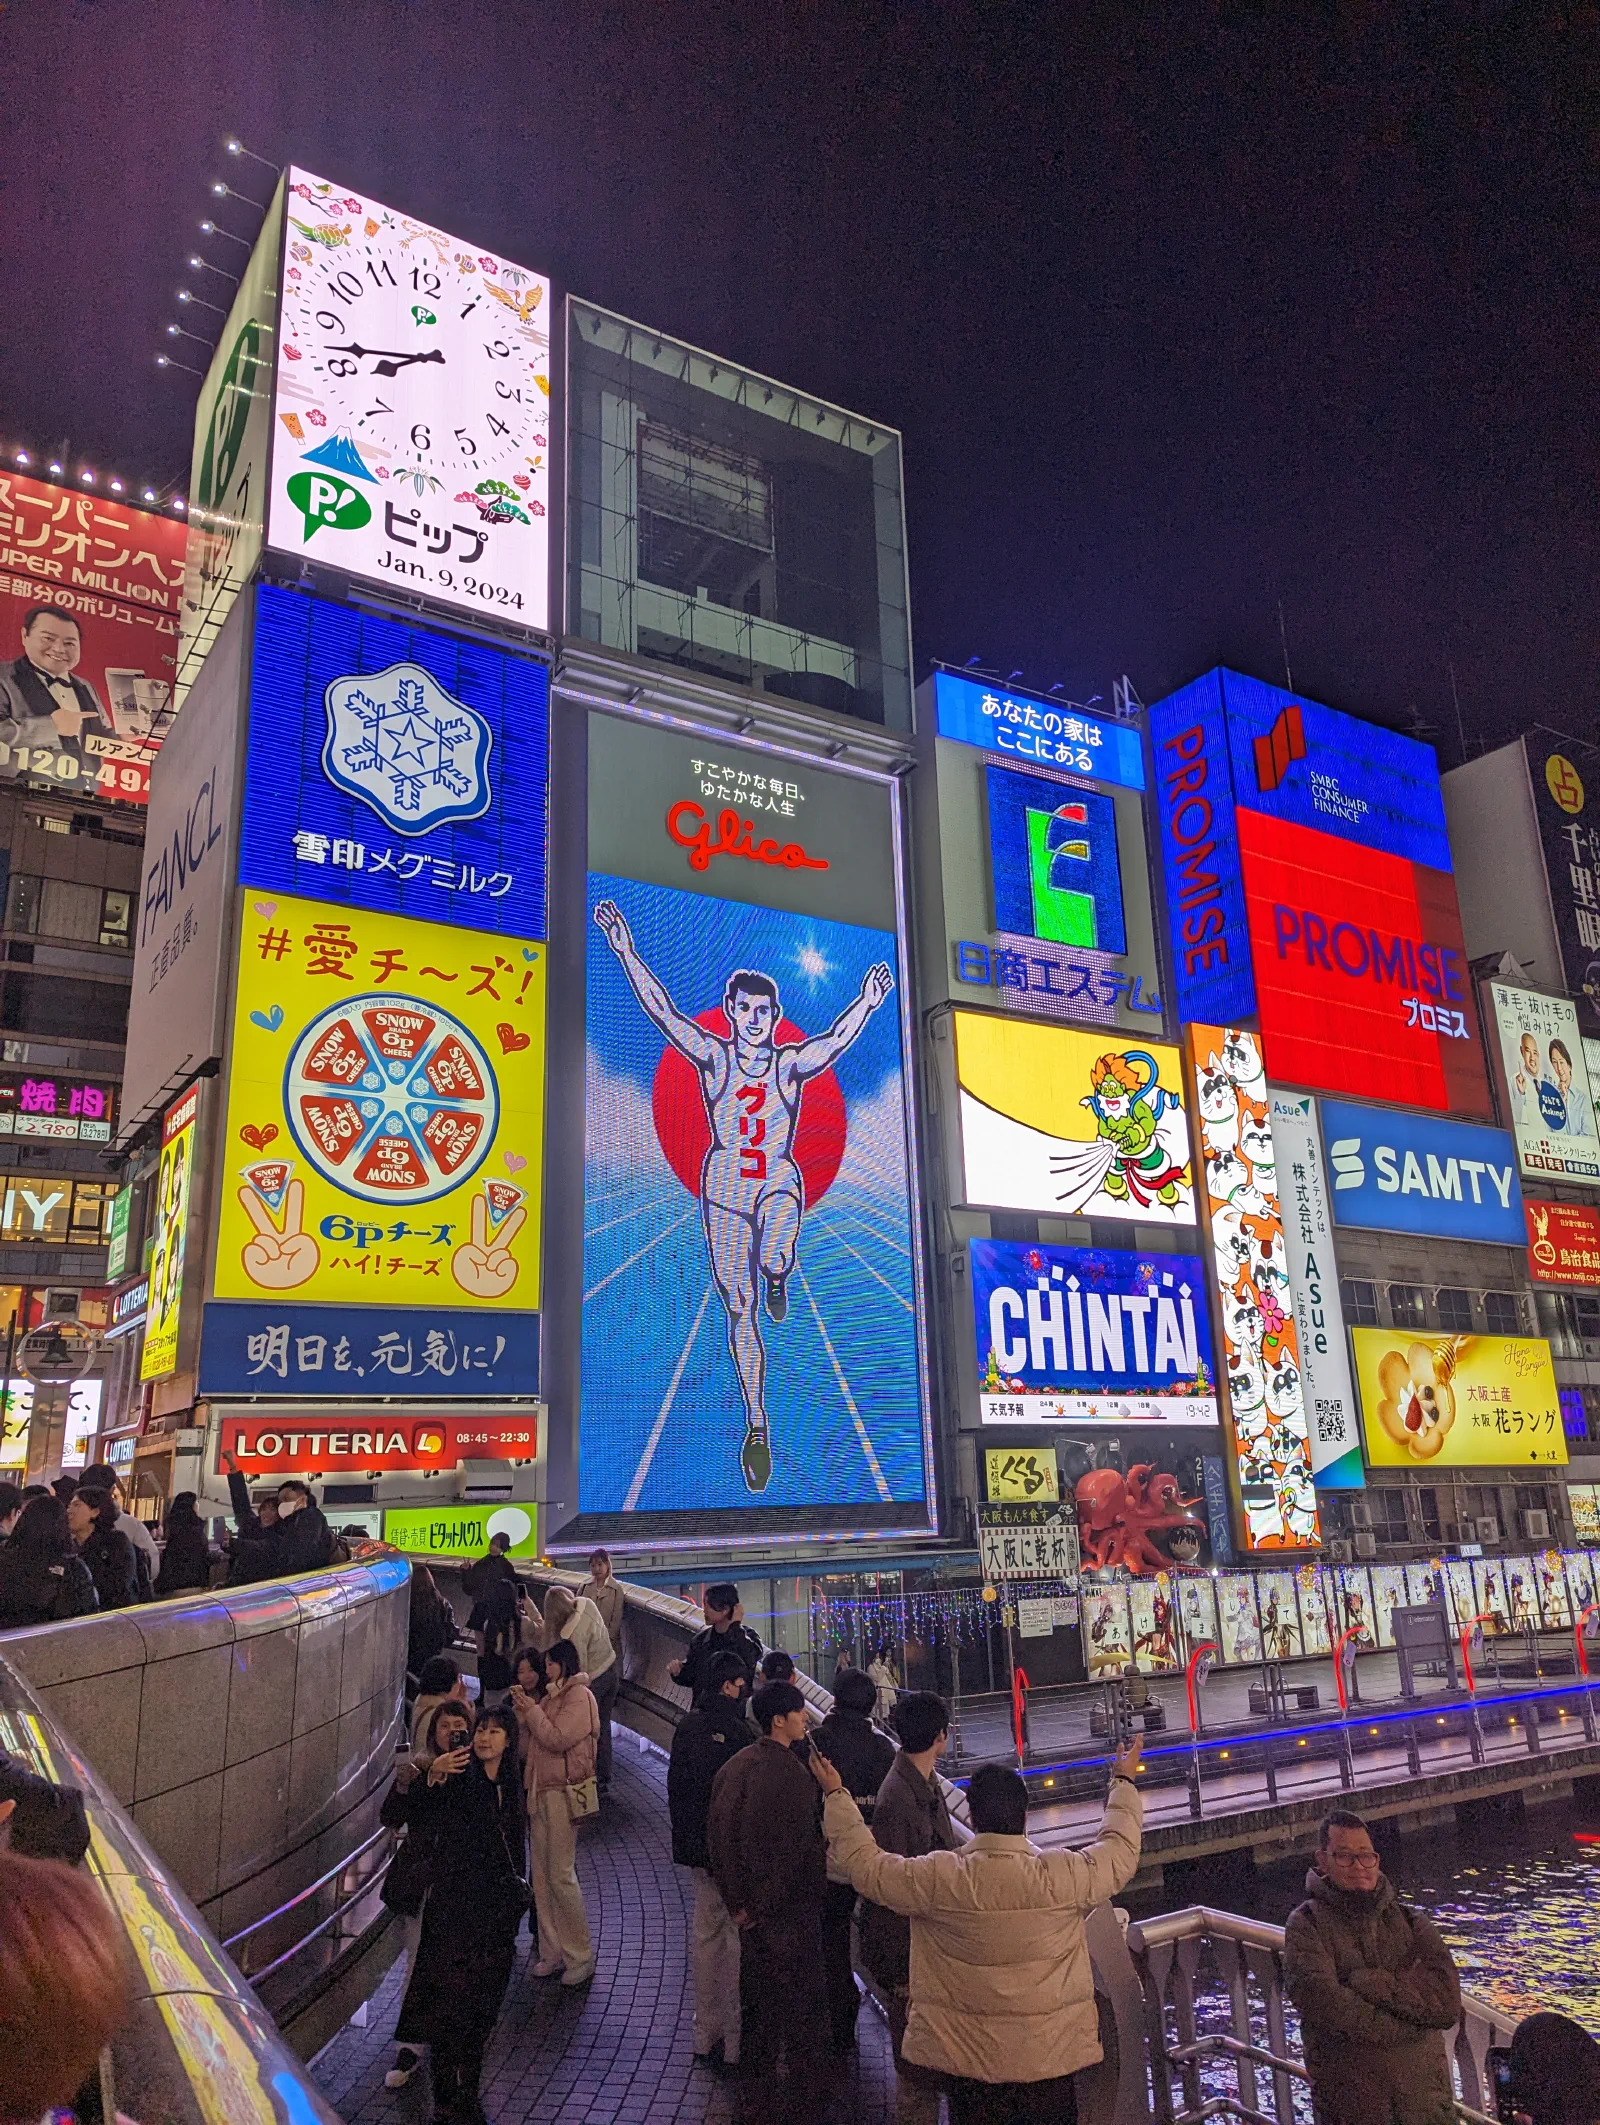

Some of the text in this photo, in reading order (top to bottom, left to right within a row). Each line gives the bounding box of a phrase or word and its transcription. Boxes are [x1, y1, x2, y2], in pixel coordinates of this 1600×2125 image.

[326, 270, 365, 307] 10
[366, 261, 399, 288] 11
[407, 266, 443, 301] 12
[315, 310, 346, 336] 9
[460, 301, 478, 321] 1
[483, 339, 514, 361] 2
[326, 358, 358, 379] 8
[495, 381, 522, 404] 3
[365, 397, 395, 418] 7
[410, 424, 431, 450] 6
[485, 413, 508, 437] 4
[454, 427, 478, 456] 5
[385, 500, 489, 564] ピップ
[377, 551, 431, 585] Jan.
[464, 577, 525, 612] 2024
[981, 693, 1103, 746] あなたの家は
[997, 726, 1093, 772] ここにある
[0, 742, 150, 793] 120-49
[691, 759, 805, 801] すこやかな毎日、
[1310, 771, 1340, 791] SMBC
[700, 780, 796, 817] ゆたかな人生
[1311, 784, 1370, 814] CONSUMER
[1313, 797, 1360, 823] FINANCE
[142, 765, 222, 948] FANCL
[292, 829, 513, 898] 雪印メグミルク
[1164, 724, 1229, 977] PROMISE
[1274, 902, 1466, 1003] PROMISE
[376, 1012, 424, 1031] SNOW
[1401, 996, 1470, 1040] プロミス
[310, 1026, 346, 1072] SNOW
[383, 1047, 413, 1058] CHEESE
[346, 1057, 367, 1083] CHEESE
[427, 1066, 446, 1094] CHEESE
[448, 1046, 479, 1091] SNOW
[344, 1101, 363, 1131] CHEESE
[1274, 1101, 1301, 1116] Asue
[305, 1106, 340, 1153] SNOW
[424, 1111, 444, 1137] CHEESE
[735, 1081, 769, 1182] グリコ
[378, 1138, 409, 1148] CHEESE
[444, 1122, 477, 1166] SNOW
[254, 1166, 282, 1178] SNOW
[366, 1168, 416, 1185] SNOW
[1373, 1146, 1513, 1210] SAMTY
[493, 1186, 516, 1198] SNOW
[1306, 1137, 1327, 1239] 丸善インテックは、
[1292, 1162, 1328, 1354] 株式会社 Asue
[119, 1280, 149, 1315] LOTTERIA
[989, 1276, 1200, 1375] CHINTAI
[246, 1324, 506, 1378] 明日を、元気に!
[1296, 1291, 1316, 1389] に変わりました。
[1466, 1385, 1512, 1402] 大阪土産
[989, 1402, 1024, 1417] 天気予報
[1185, 1405, 1211, 1418] 19:42
[1471, 1407, 1557, 1434] 大阪 花ラング
[236, 1434, 409, 1458] LOTTERIA
[981, 1508, 1049, 1525] 大阪もんを食す
[1062, 1517, 1074, 1525] 2F
[429, 1520, 484, 1549] ピタットハウス
[986, 1535, 1066, 1570] 大阪に乾杯
[1111, 1627, 1121, 1639] あ
[1140, 1616, 1149, 1628] け
[1199, 1623, 1205, 1634] ま
